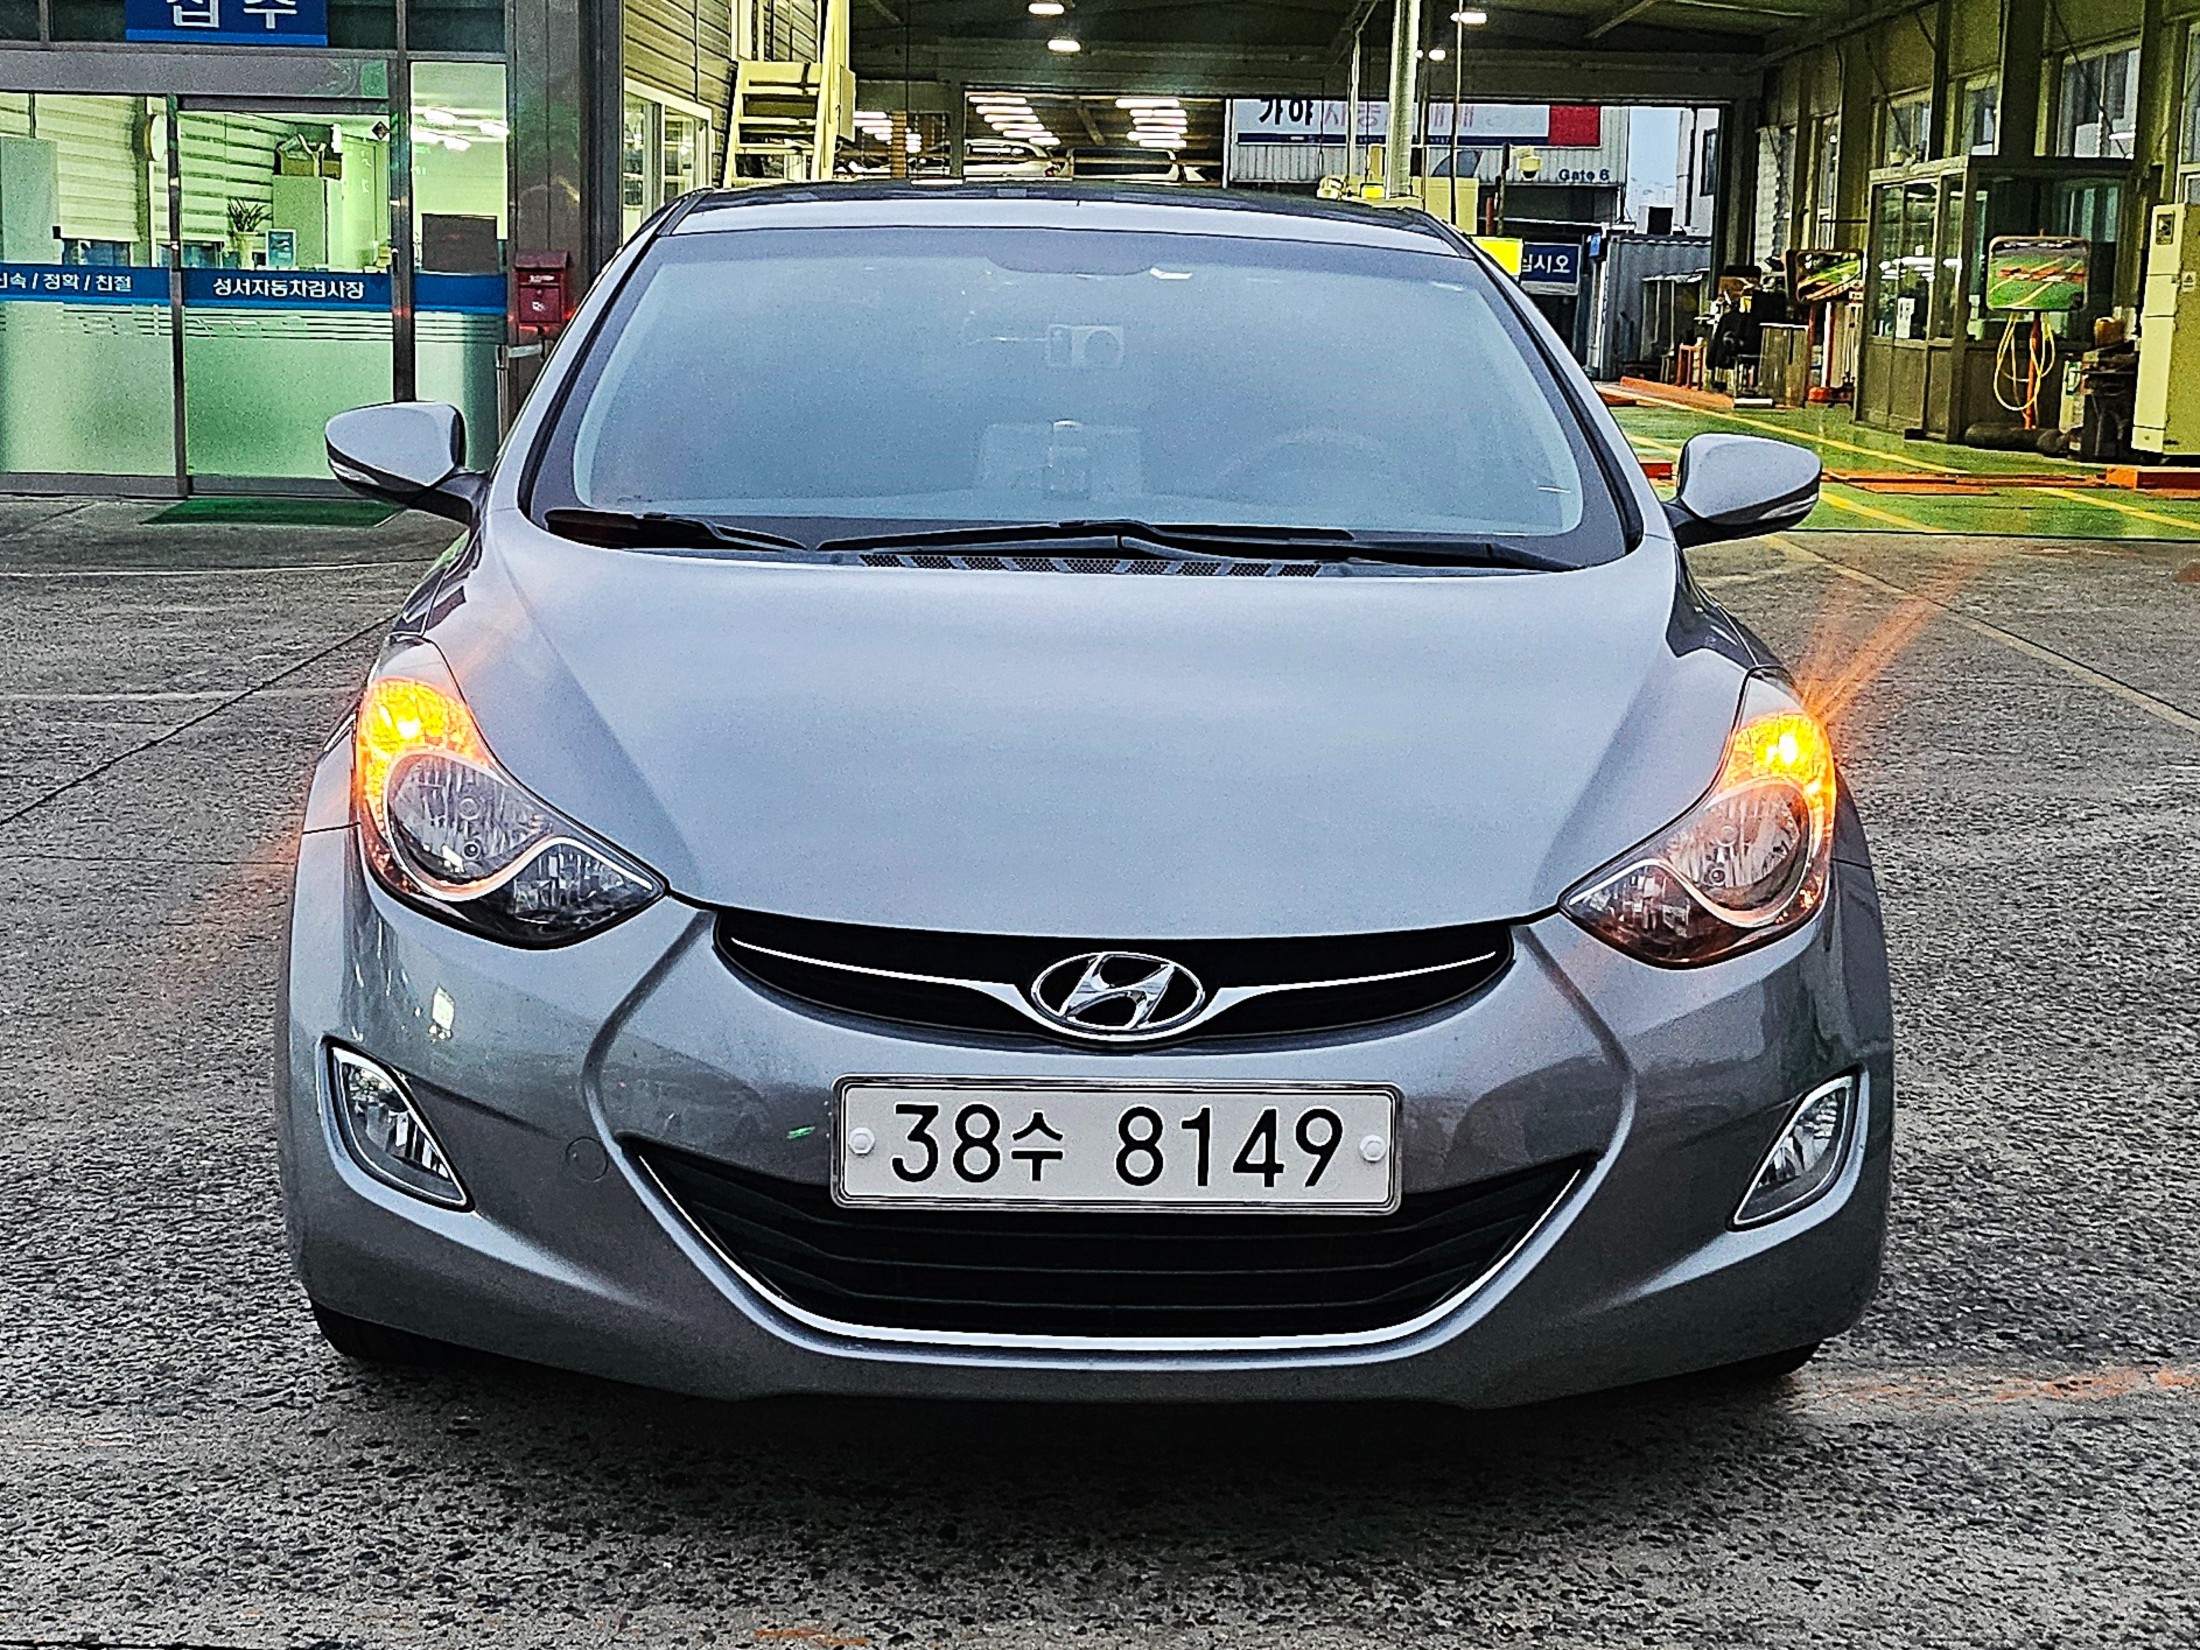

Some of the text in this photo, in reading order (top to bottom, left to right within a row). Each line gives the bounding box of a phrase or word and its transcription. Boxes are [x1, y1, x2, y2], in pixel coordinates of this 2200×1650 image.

[1259, 99, 1314, 126] 가야
[1558, 168, 1595, 182] Gate
[43, 272, 80, 291] 정확
[95, 274, 132, 293] 친절
[213, 277, 365, 300] 성서자동차검사장
[891, 1102, 1344, 1189] 38수 8149
